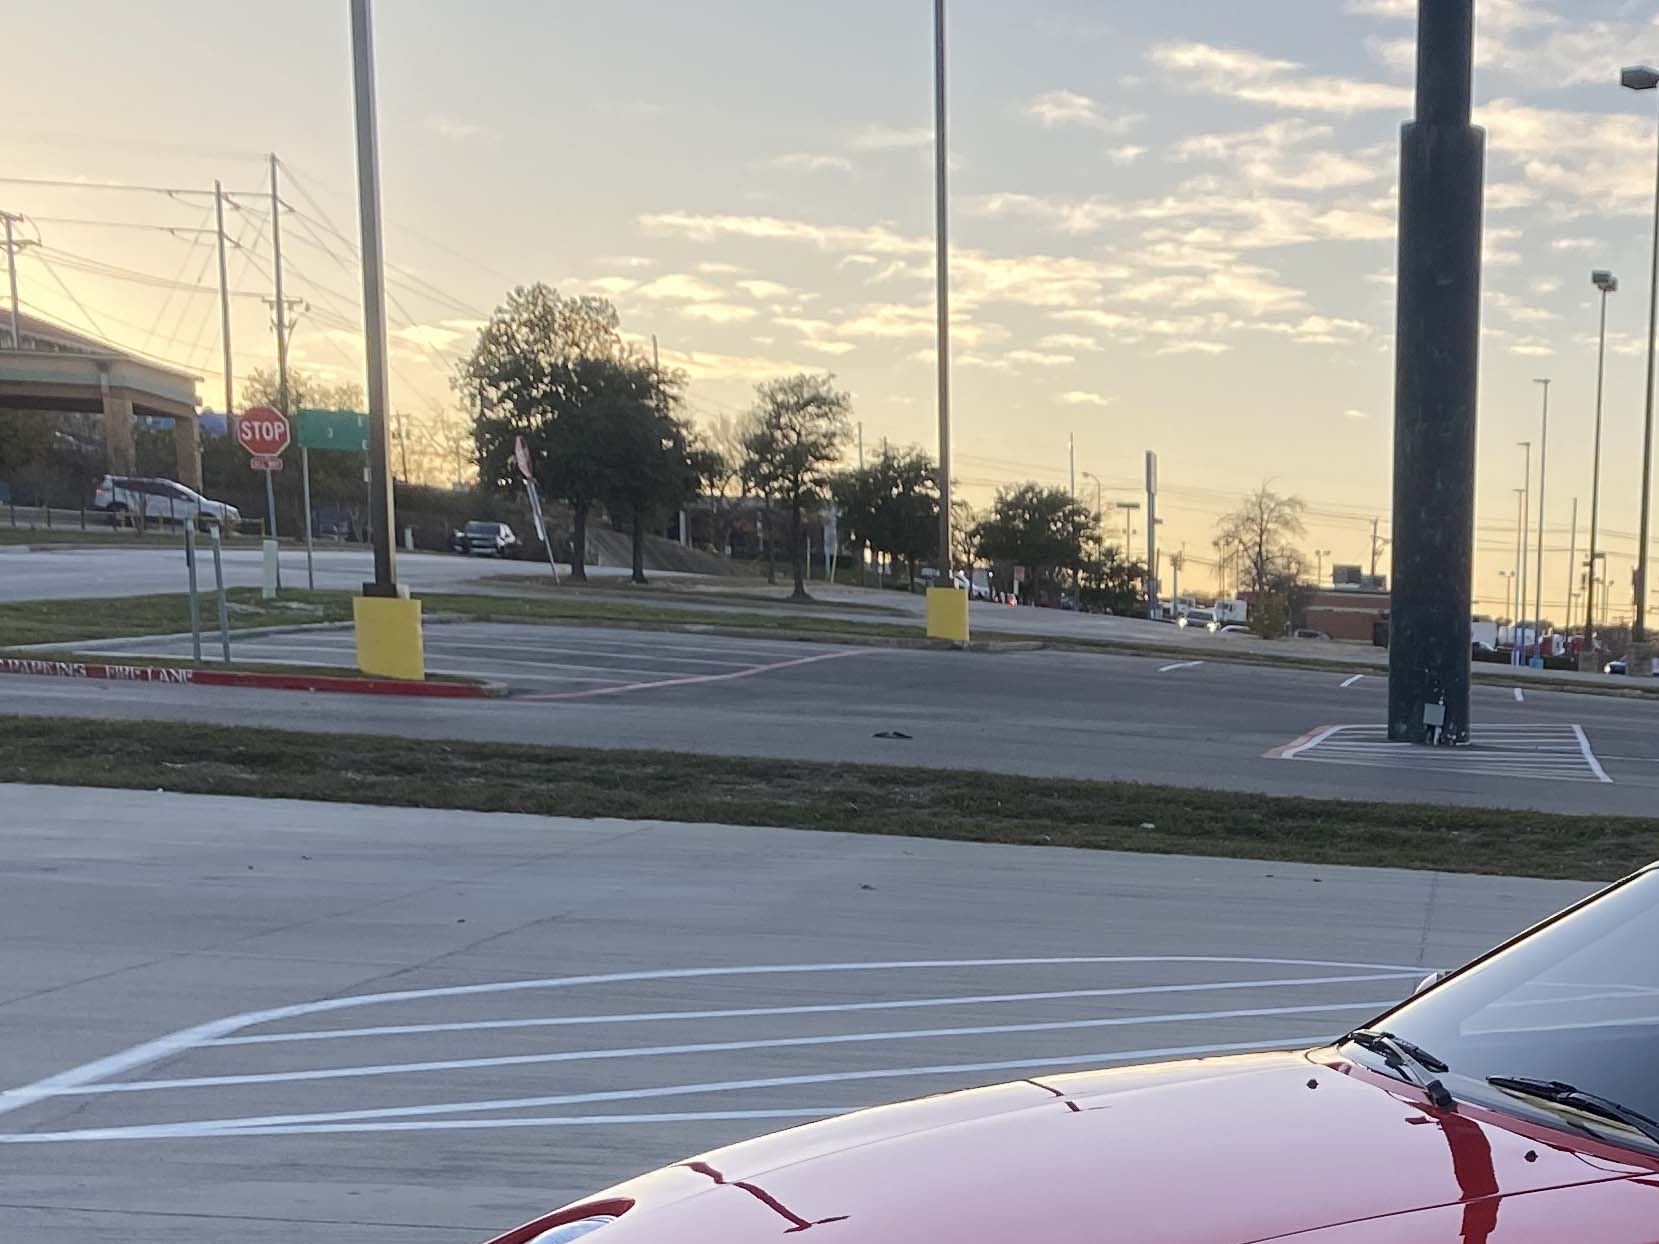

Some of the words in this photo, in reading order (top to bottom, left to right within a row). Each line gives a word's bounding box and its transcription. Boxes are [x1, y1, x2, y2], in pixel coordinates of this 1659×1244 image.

[241, 420, 285, 441] STOP
[105, 665, 141, 680] FIRE
[147, 667, 192, 684] LANE
